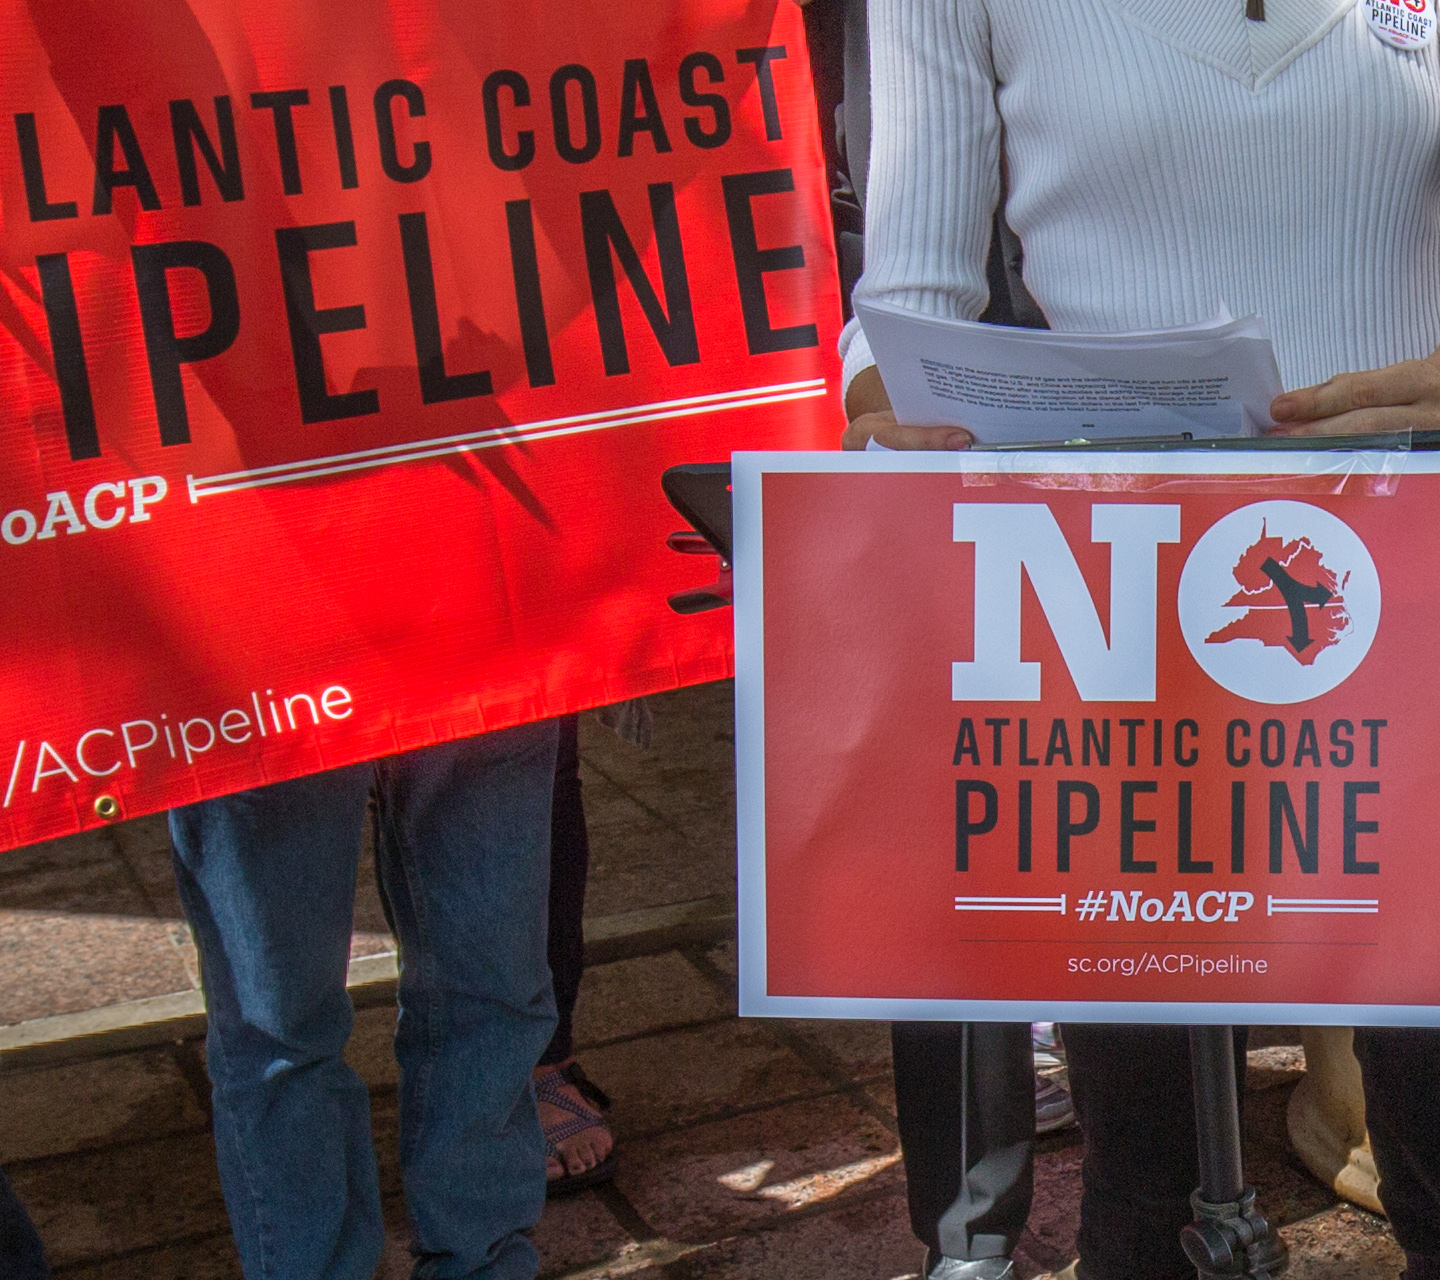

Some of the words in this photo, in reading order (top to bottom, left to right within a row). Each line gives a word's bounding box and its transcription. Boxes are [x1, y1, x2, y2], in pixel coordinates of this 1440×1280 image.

[1371, 8, 1427, 40] PIPELINE
[1407, 12, 1432, 28] COAST
[482, 44, 789, 172] COAST
[951, 498, 1383, 704] NO
[953, 717, 1200, 768] ATLANTIC
[1225, 718, 1389, 769] COAST
[955, 779, 1382, 876] PIPELINE
[1074, 888, 1255, 923] #NoACP
[1067, 953, 1269, 978] sc.org/ACPipeline
